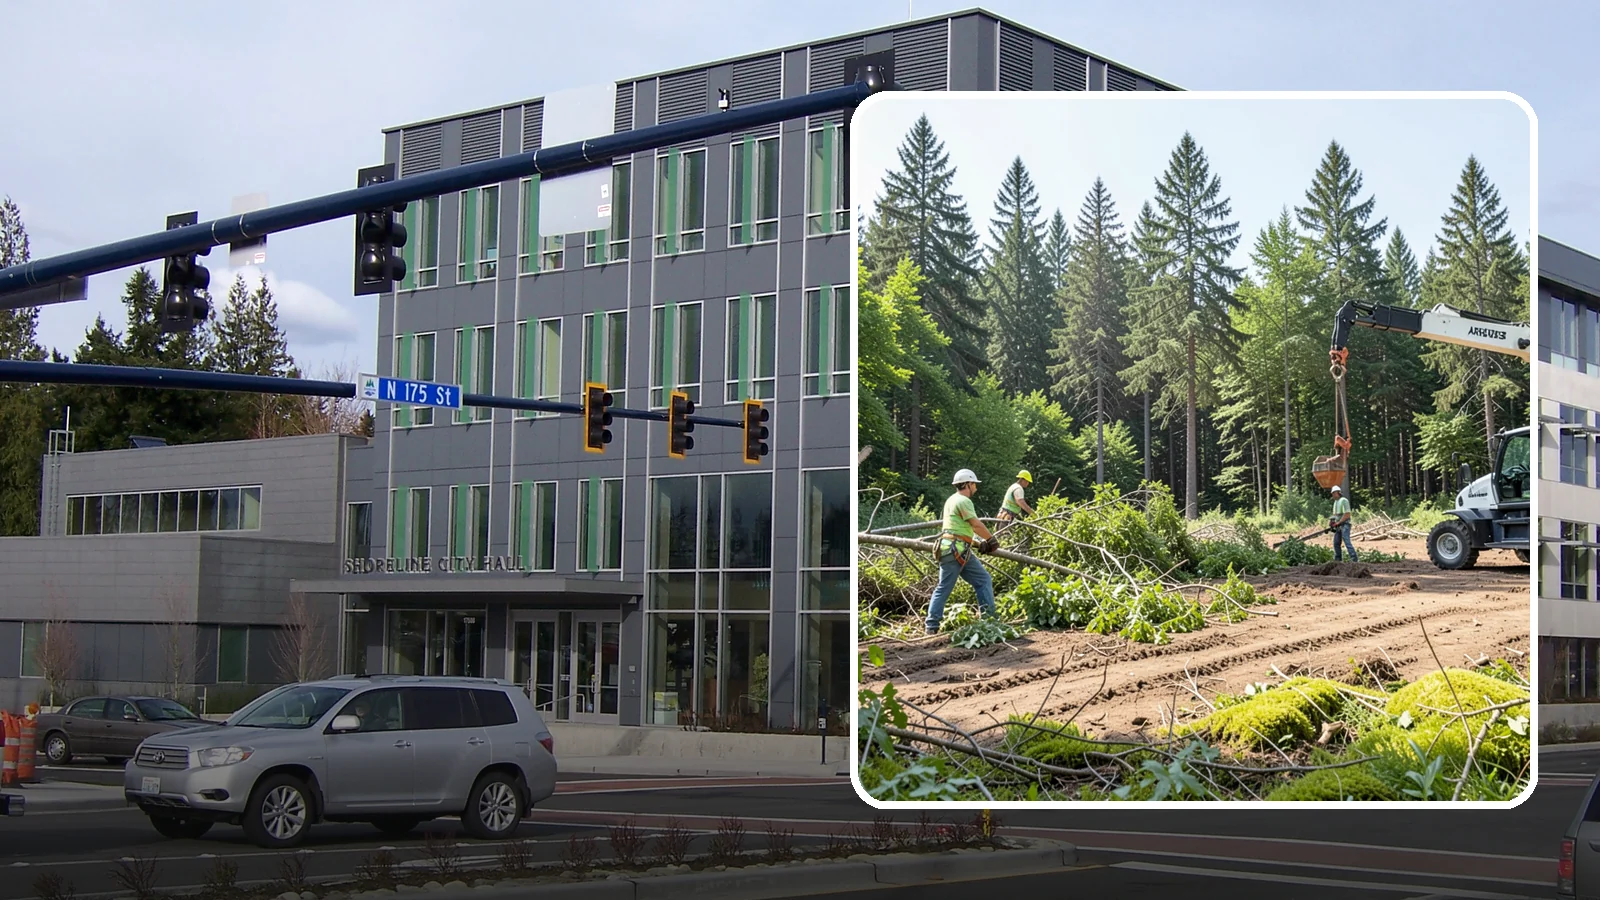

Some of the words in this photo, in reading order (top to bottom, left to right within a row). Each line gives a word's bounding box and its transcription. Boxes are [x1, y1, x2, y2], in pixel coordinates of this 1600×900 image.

[387, 380, 396, 400] N
[405, 382, 428, 403] 175
[436, 386, 452, 406] St
[344, 556, 433, 575] SHORELINE
[438, 556, 476, 574] CITY
[484, 555, 526, 573] HALL
